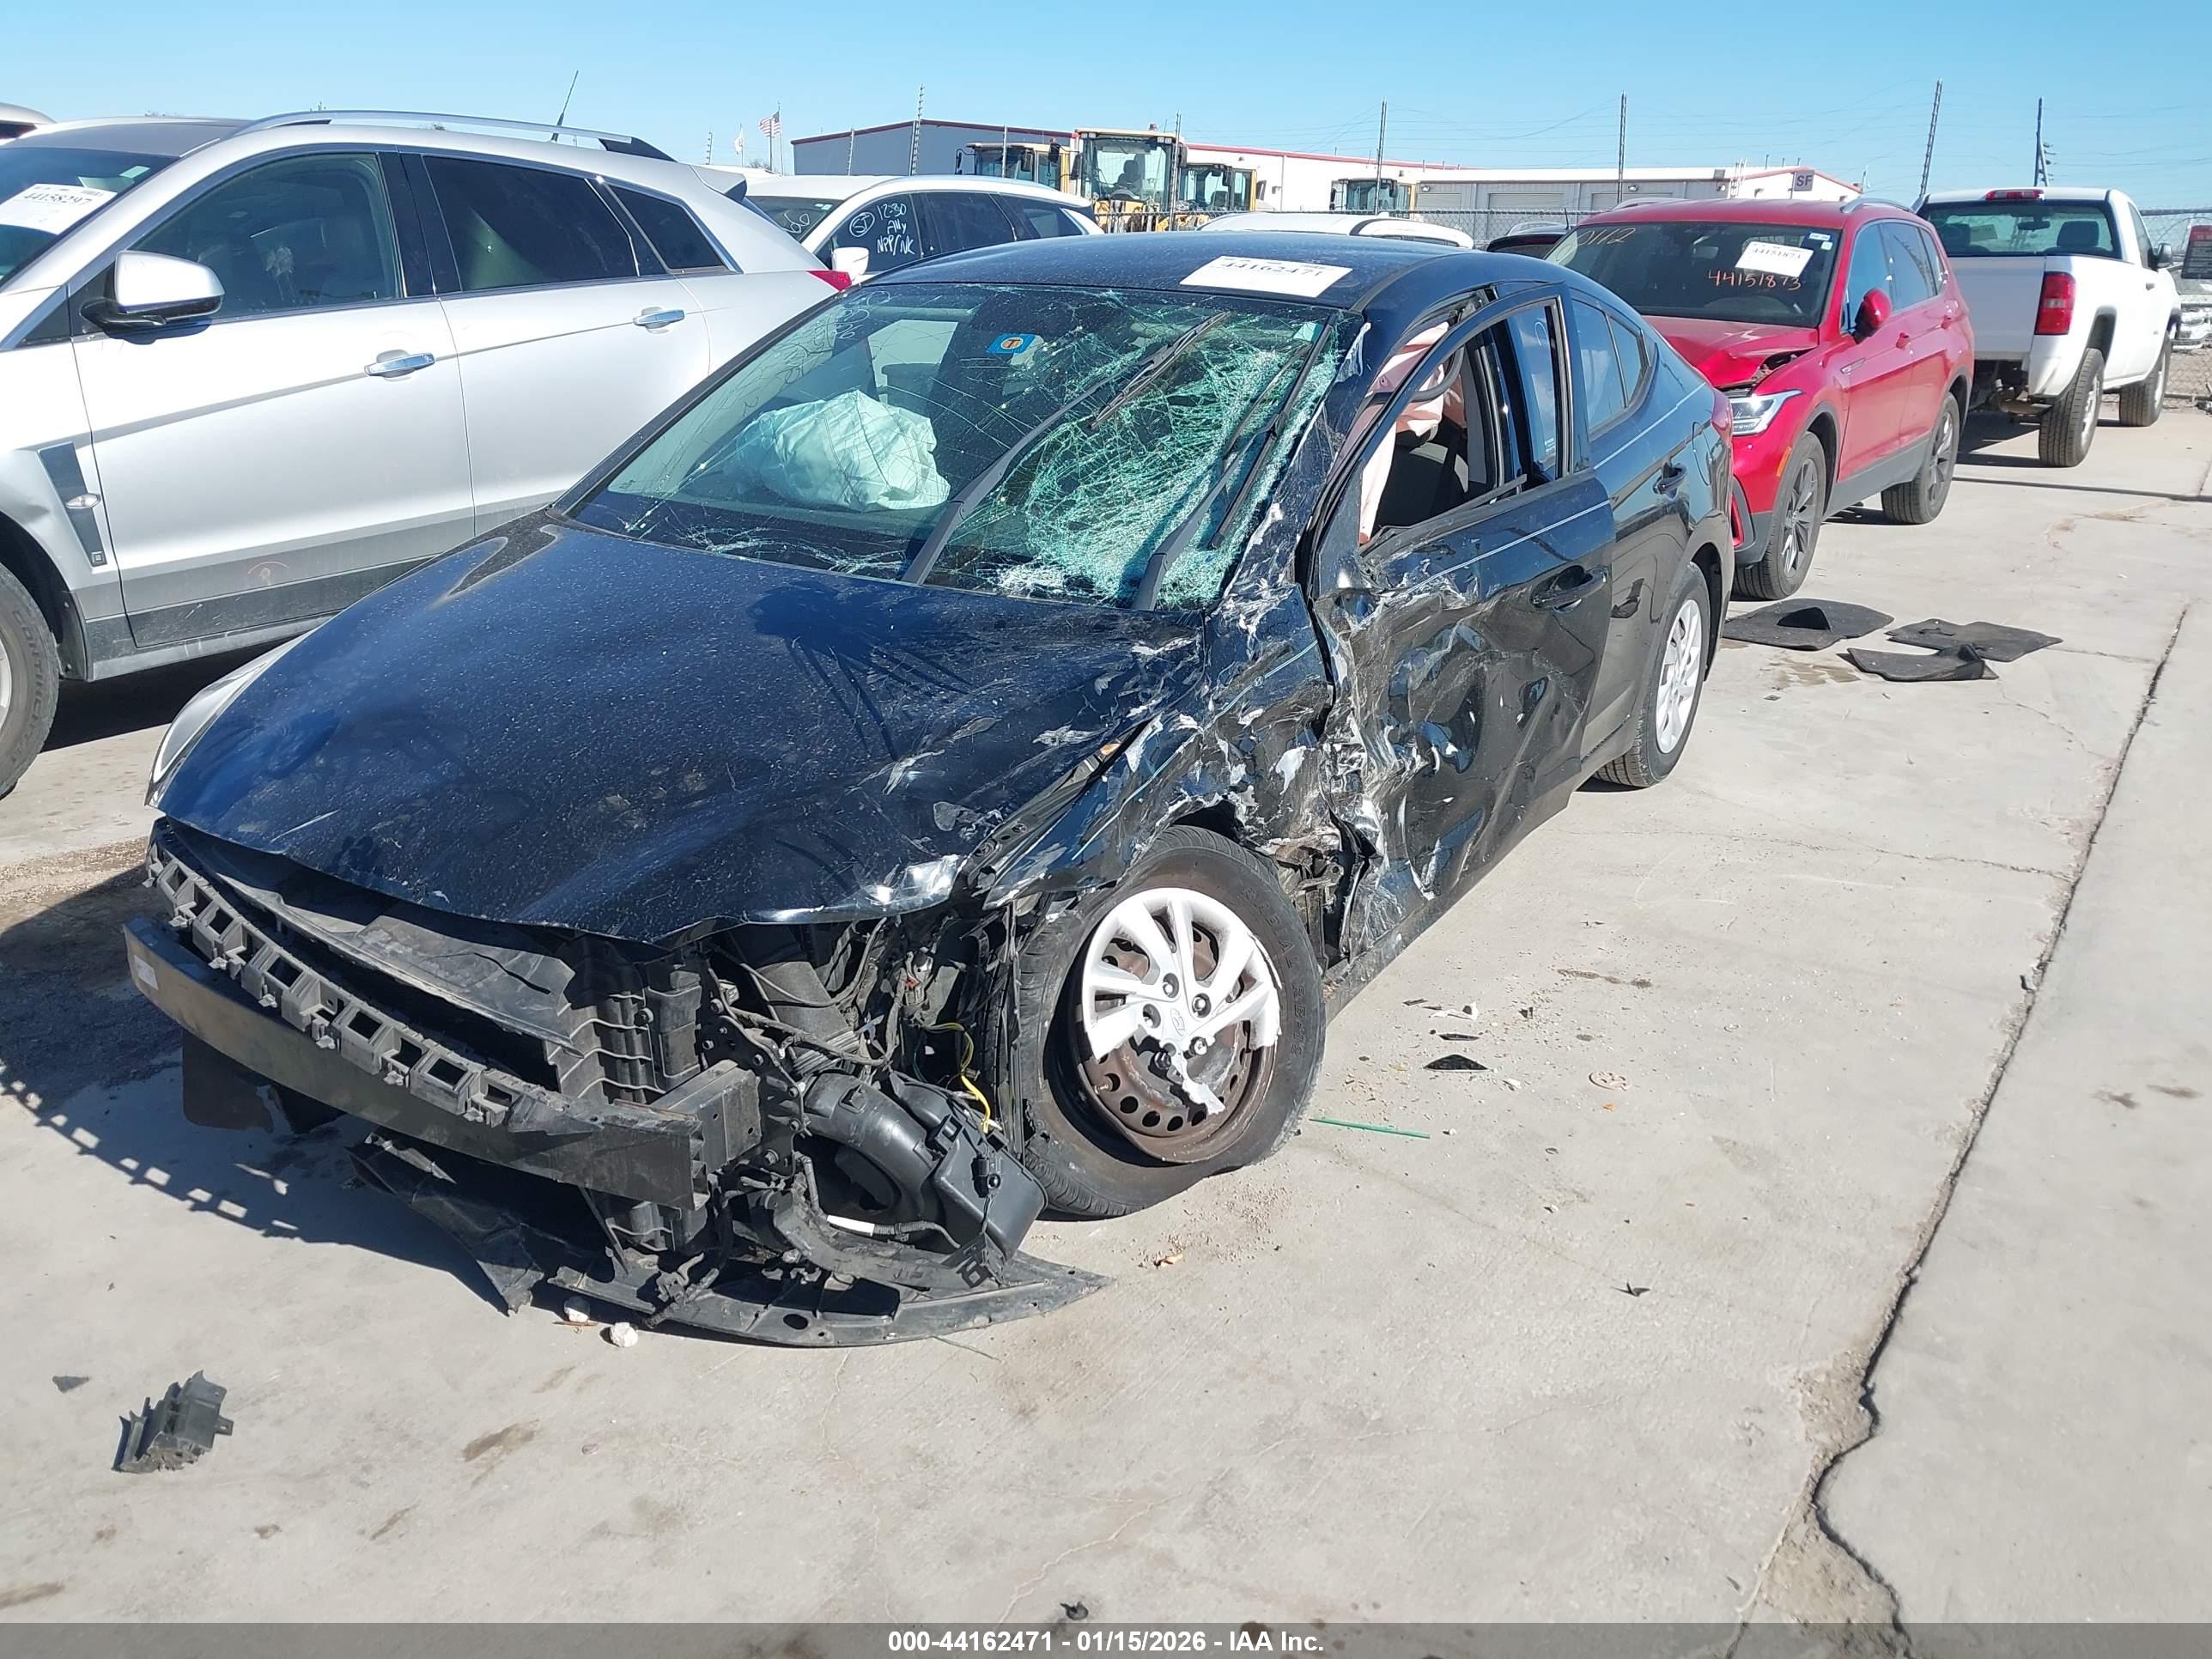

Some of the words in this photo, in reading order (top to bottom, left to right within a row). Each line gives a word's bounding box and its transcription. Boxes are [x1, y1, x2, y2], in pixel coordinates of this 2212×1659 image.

[1796, 174, 1813, 187] SF
[1222, 262, 1323, 276] 44162471
[1708, 270, 1802, 290] 44151873
